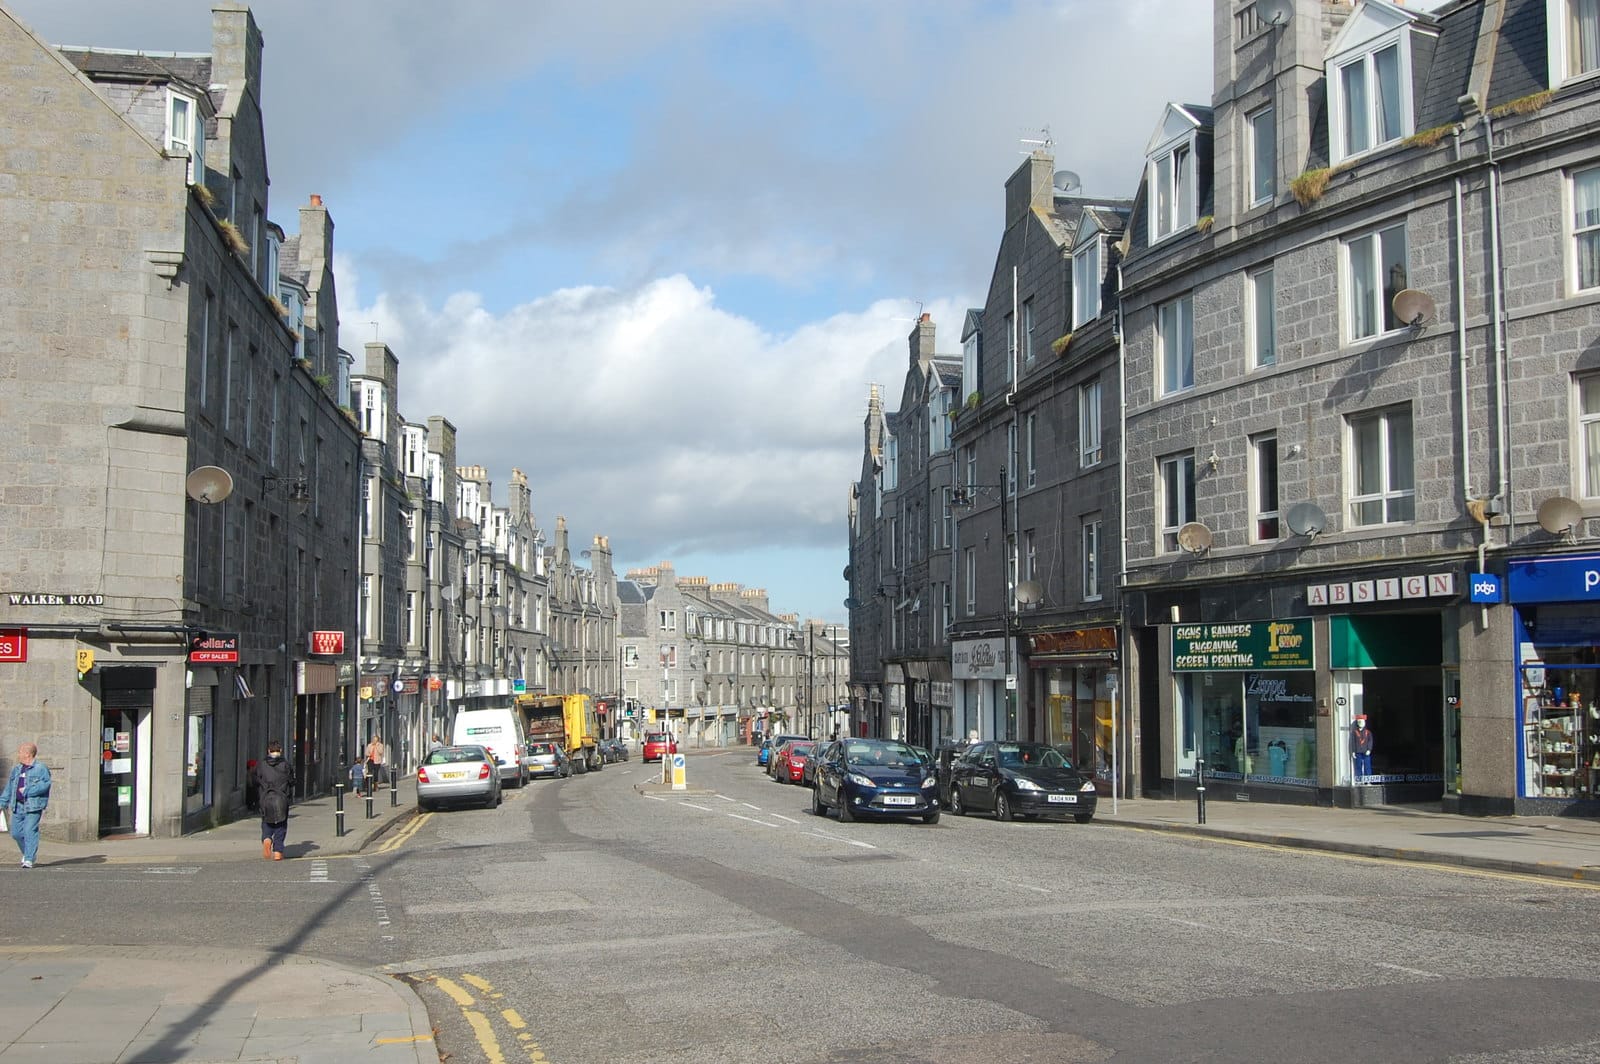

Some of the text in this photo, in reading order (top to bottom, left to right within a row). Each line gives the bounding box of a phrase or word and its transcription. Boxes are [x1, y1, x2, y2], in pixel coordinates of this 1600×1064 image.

[1312, 576, 1447, 603] ABSIGN
[1474, 580, 1496, 596] pdsa
[10, 594, 103, 604] WALKER ROAD
[1176, 626, 1201, 640] SIGNS
[1211, 624, 1252, 638] BANNERS
[1268, 622, 1280, 653] 1
[1189, 640, 1238, 654] ENGRAVING
[1278, 635, 1303, 648] SHOP
[1175, 654, 1209, 668] SCREEN
[1211, 653, 1254, 667] PRINTING
